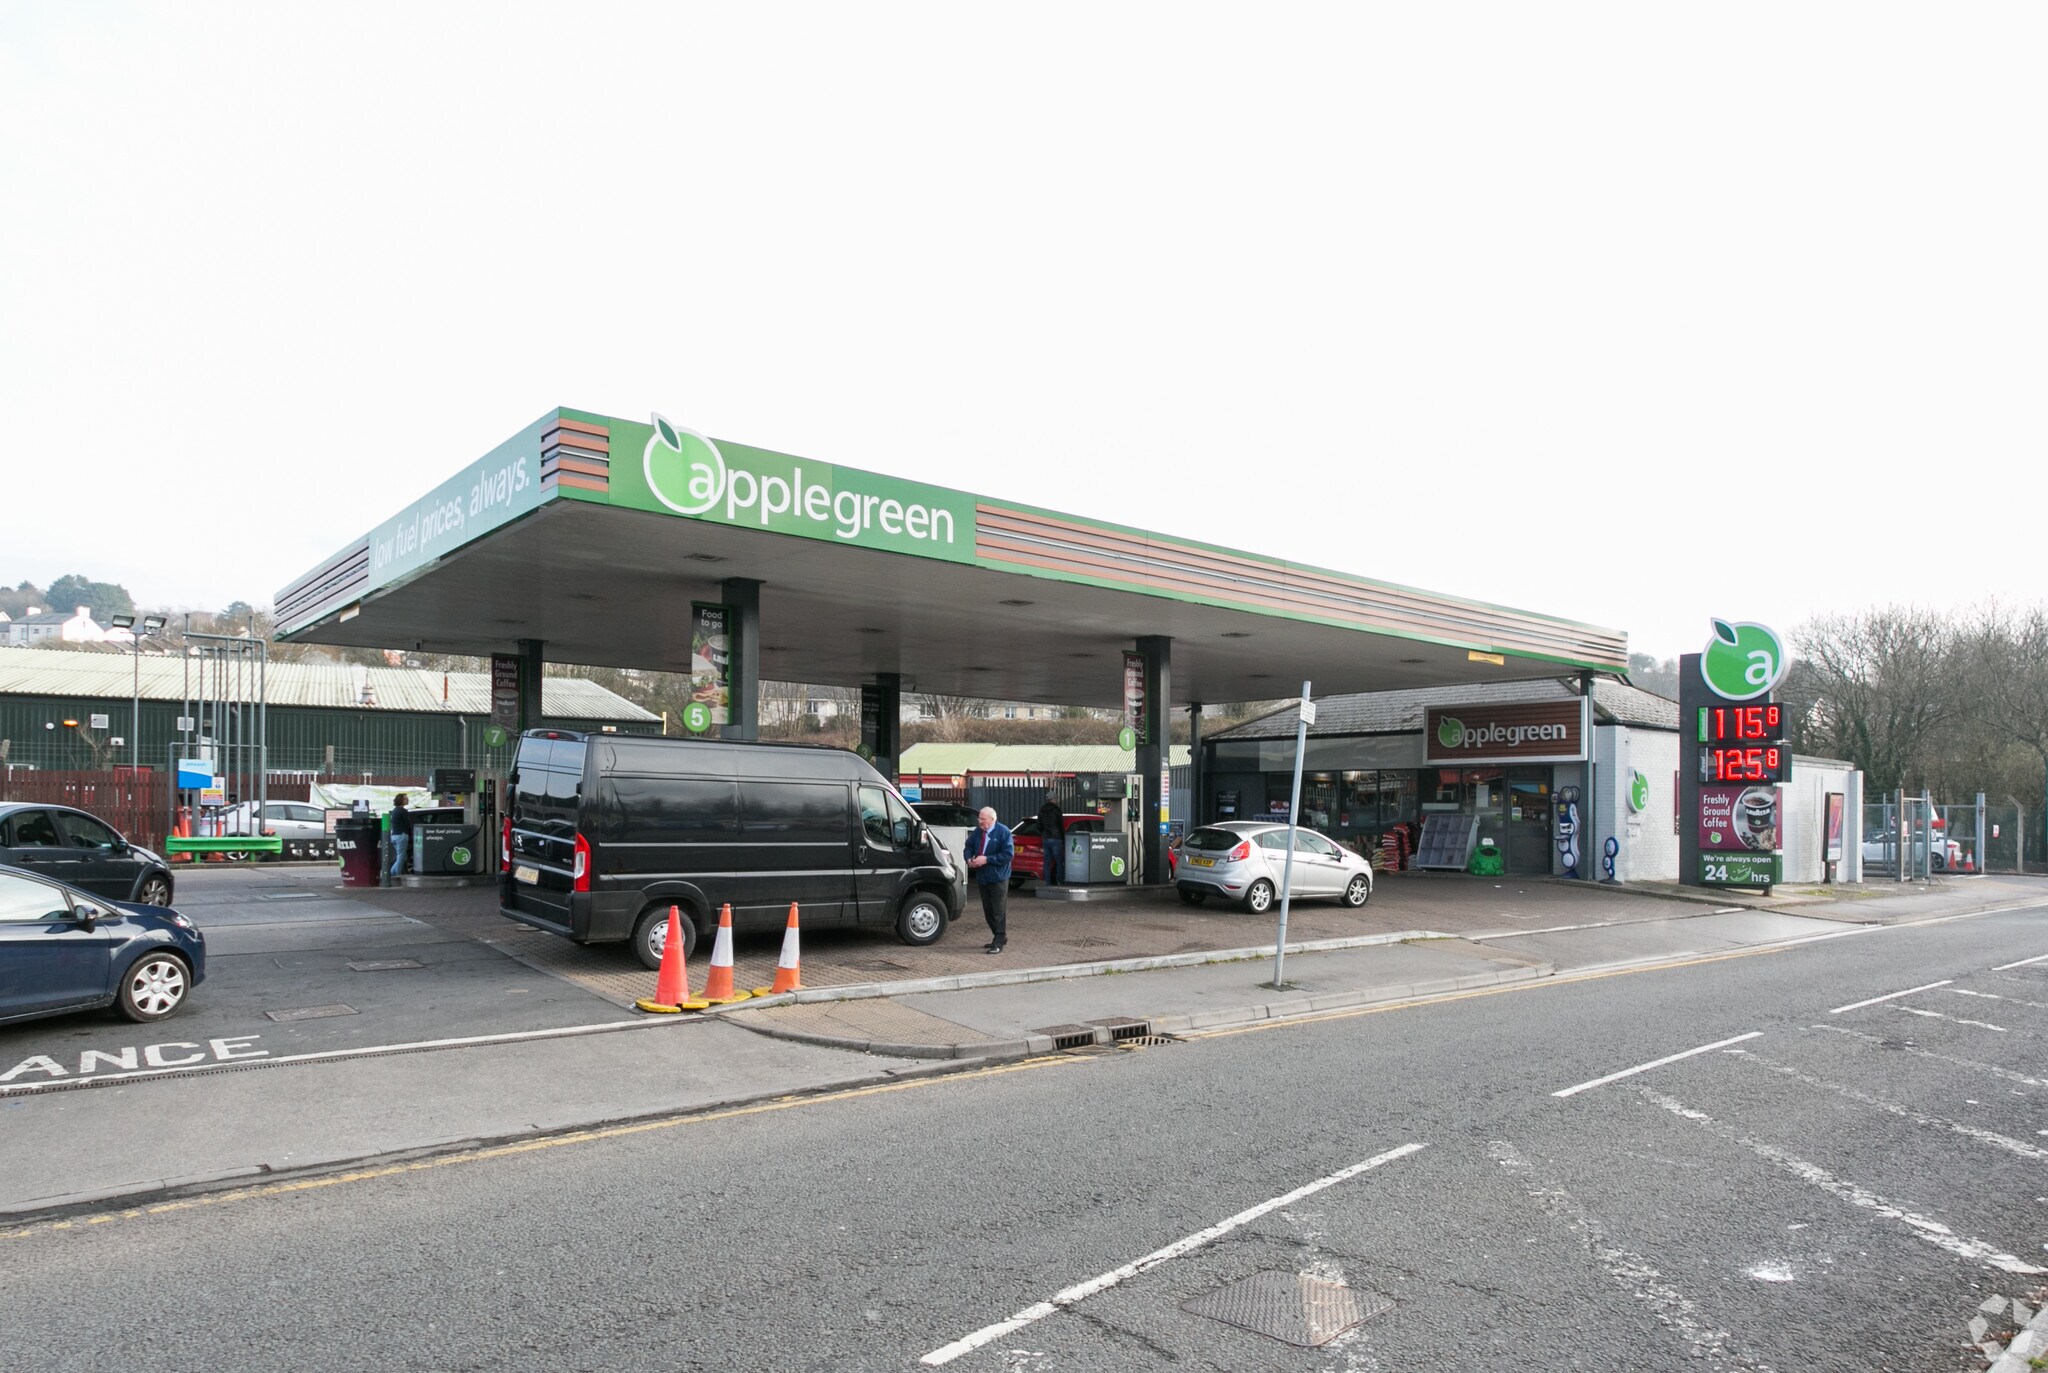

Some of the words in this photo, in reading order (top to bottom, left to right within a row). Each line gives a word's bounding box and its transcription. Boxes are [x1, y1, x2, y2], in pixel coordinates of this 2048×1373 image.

[688, 462, 954, 544] applegreen
[374, 535, 397, 571] low
[396, 512, 417, 559] fuel
[420, 494, 465, 554] prices,
[469, 456, 530, 518] always.
[701, 609, 723, 620] Food
[701, 618, 710, 627] to
[711, 620, 723, 629] go
[494, 660, 518, 672] Freshly
[1126, 658, 1144, 670] Freshly
[494, 670, 518, 679] Ground
[1126, 668, 1144, 678] Ground
[496, 679, 516, 688] Coffee
[1127, 678, 1143, 688] Coffee
[690, 708, 704, 727] 5
[490, 729, 501, 743] 7
[1124, 732, 1130, 746] 1
[1451, 721, 1567, 748] applegreen
[861, 747, 868, 758] 3
[1703, 793, 1730, 806] Freshly
[1703, 806, 1730, 816] Ground
[1703, 818, 1728, 828] Coffee
[1702, 854, 1724, 863] We're
[1725, 855, 1751, 864] always
[1704, 864, 1729, 881] 24
[1751, 871, 1771, 883] hrs
[0, 1034, 270, 1082] ANCE
